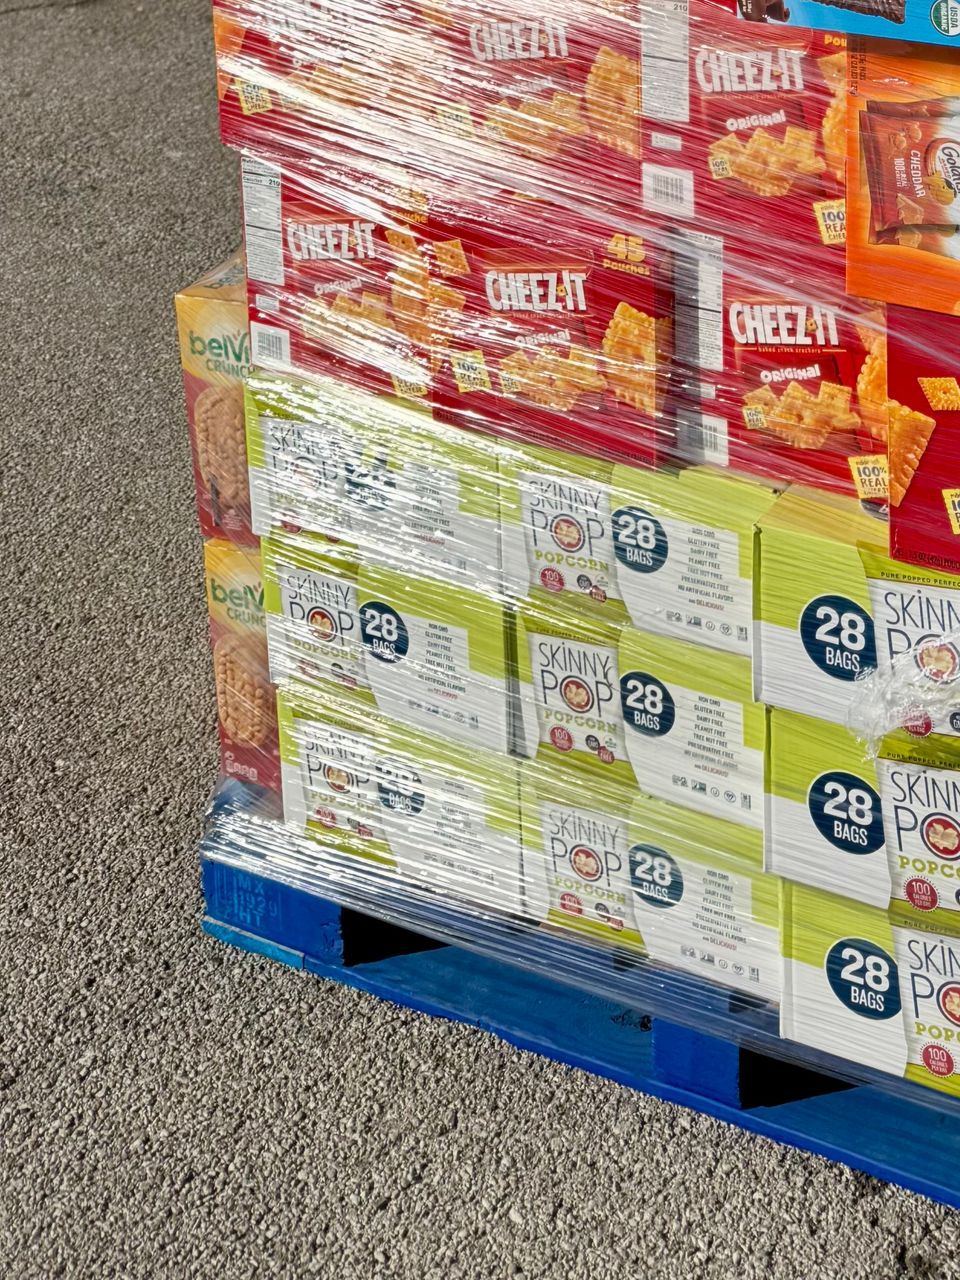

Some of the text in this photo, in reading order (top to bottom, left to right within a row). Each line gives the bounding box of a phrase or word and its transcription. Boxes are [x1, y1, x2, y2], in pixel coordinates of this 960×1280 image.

[673, 3, 688, 12] 210
[949, 5, 959, 30] USDA
[910, 149, 926, 198] CHEDDAR
[607, 233, 646, 262] 45
[188, 329, 251, 366] belVi
[856, 466, 888, 477] 100%
[860, 477, 889, 488] REAL
[531, 509, 605, 557] POP
[617, 513, 656, 550] 28
[534, 549, 610, 573] POPCORN
[626, 547, 653, 567] BAGS
[880, 571, 900, 580] PURE
[902, 574, 931, 584] POPPED
[364, 608, 399, 642] 28
[815, 605, 867, 651] 28
[372, 638, 397, 656] BAGS
[825, 647, 861, 672] BAGS
[540, 669, 613, 718] POP
[626, 678, 664, 715] 28
[543, 709, 618, 735] POPCORN
[634, 710, 660, 730] BAGS
[693, 703, 725, 718] GLUTEN FREE
[711, 718, 724, 728] FREE
[694, 723, 726, 738] PEANUT FREE
[823, 781, 874, 827] 28
[833, 820, 868, 846] BAGS
[551, 836, 623, 888] POP
[634, 851, 672, 887] 28
[642, 882, 669, 900] BAGS
[840, 947, 890, 993] 28
[850, 985, 885, 1012] BAGS
